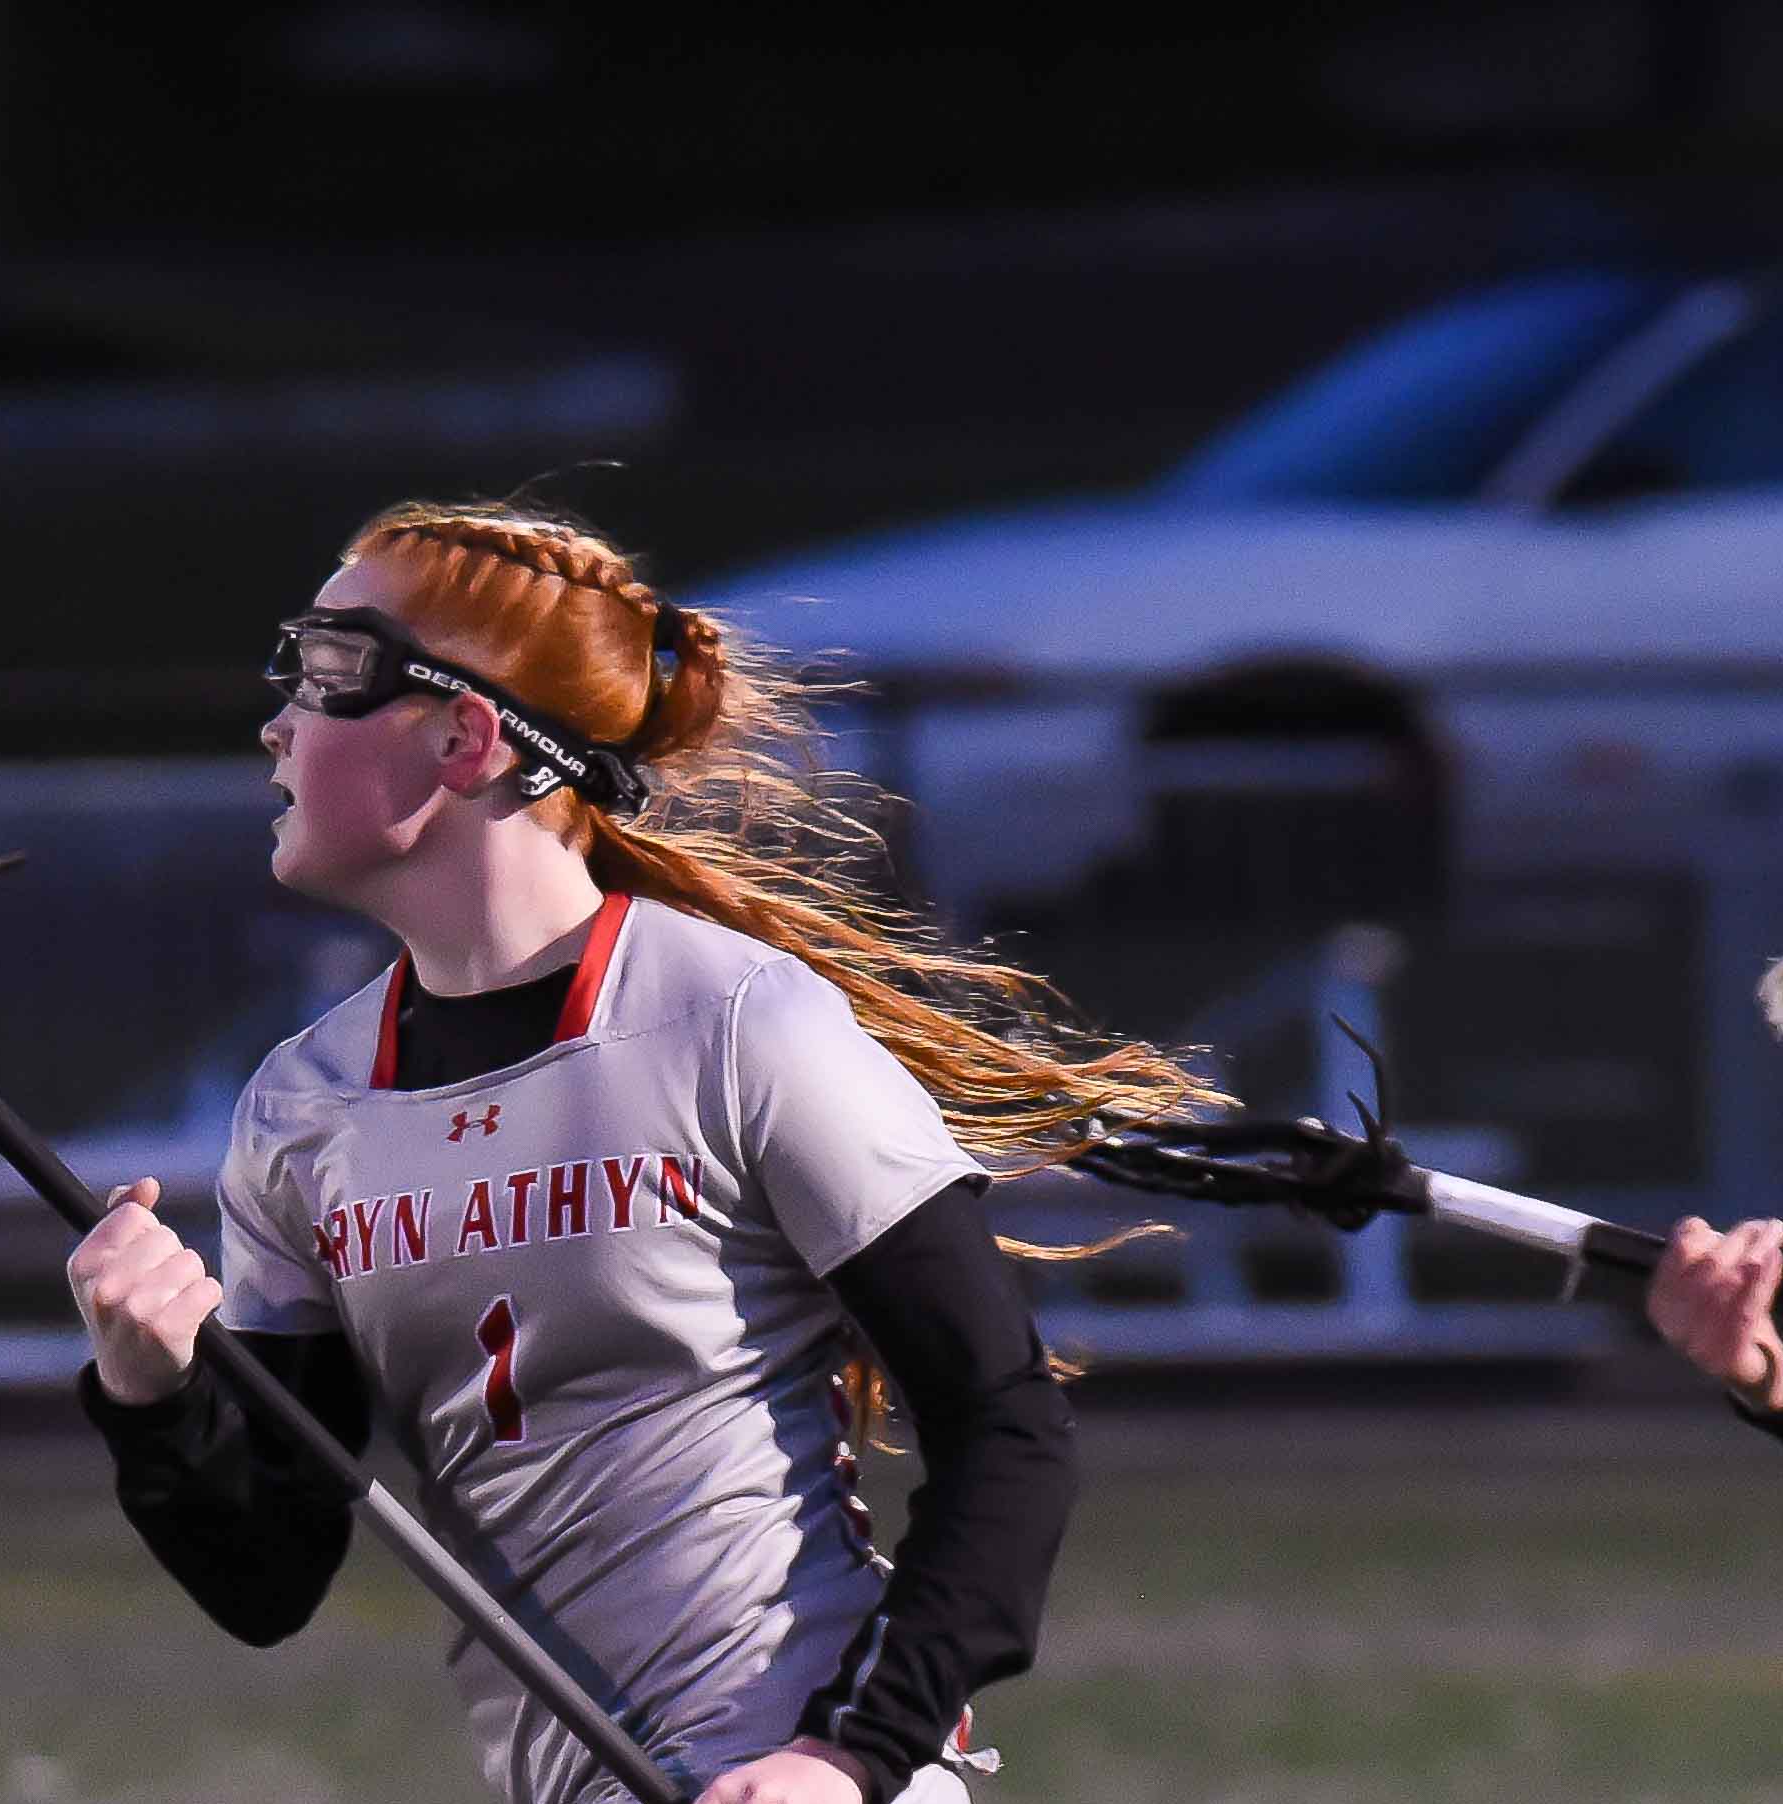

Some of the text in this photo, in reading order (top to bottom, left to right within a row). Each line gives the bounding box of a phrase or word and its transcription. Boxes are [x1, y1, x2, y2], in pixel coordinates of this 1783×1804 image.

[486, 698, 586, 777] RMOUR
[453, 1152, 705, 1257] ATHYN
[475, 1293, 527, 1447] 1
